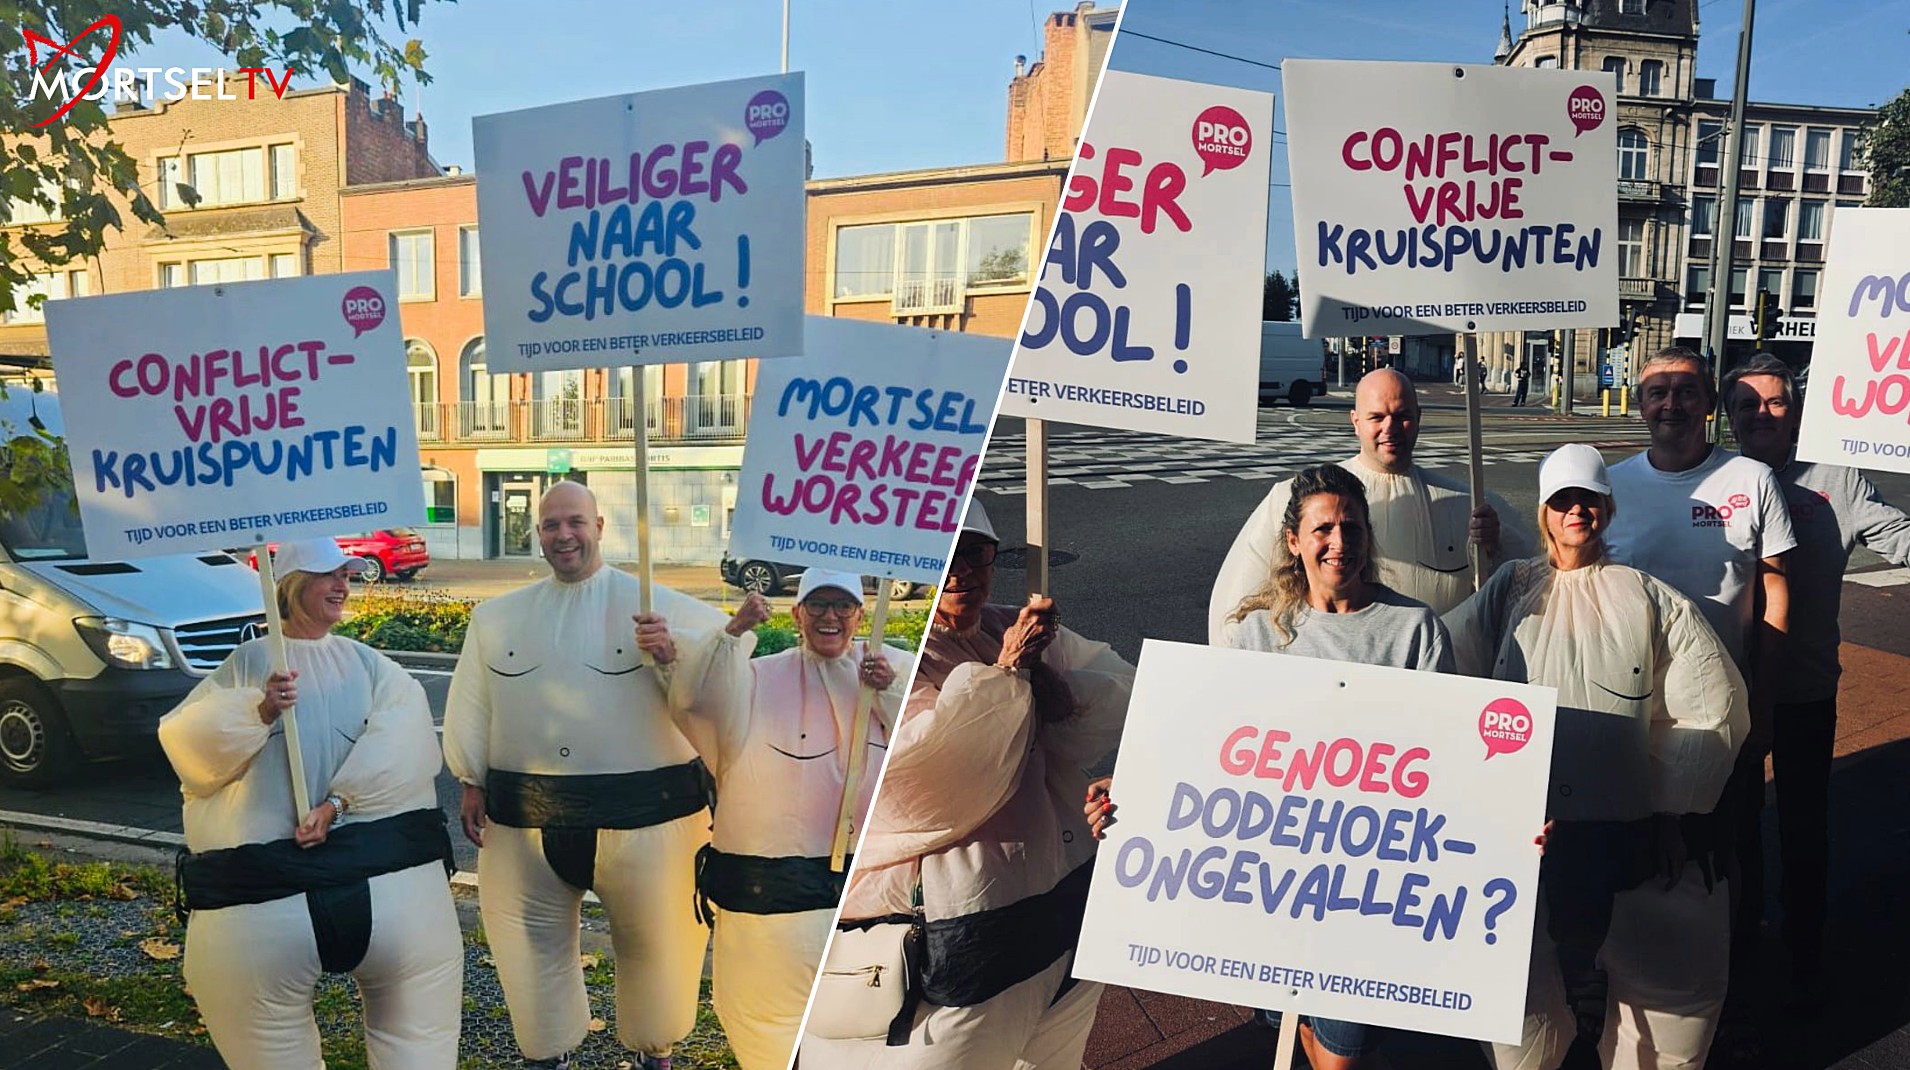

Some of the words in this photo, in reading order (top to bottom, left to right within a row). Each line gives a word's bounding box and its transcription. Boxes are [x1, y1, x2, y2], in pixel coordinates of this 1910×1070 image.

[749, 102, 787, 121] PRO
[1571, 97, 1603, 112] PRO
[1571, 112, 1602, 120] MORTSEL
[1198, 121, 1249, 147] PRO
[1198, 143, 1246, 157] MORTSEL
[1342, 127, 1574, 181] CONFLICT-
[522, 140, 748, 217] VEILIGER
[1404, 178, 1525, 227] VRIJE
[567, 200, 701, 266] NAAR
[1318, 220, 1601, 275] KRUISPUNTEN
[345, 298, 382, 314] PRO
[528, 257, 723, 323] SCHOOL
[1342, 307, 1369, 323] TIJD
[1371, 304, 1413, 319] VOOR
[1416, 304, 1442, 318] EEN
[1445, 303, 1484, 316] BETER
[1486, 300, 1587, 315] VERKEERSBELEID
[517, 343, 541, 358] TIJD
[543, 341, 580, 354] VOOR
[582, 338, 607, 351] EEN
[610, 335, 649, 350] BETER
[651, 327, 764, 346] VERKEERSBELEID
[109, 341, 355, 401] CONFLICT-
[174, 387, 305, 443] VRIJE
[778, 377, 986, 434] MORTSEL
[1006, 378, 1051, 397] ETER
[1054, 383, 1206, 416] VERKEERSBELEID
[93, 425, 397, 498] KRUISPUNTEN
[1841, 439, 1870, 455] TIJD
[125, 528, 153, 545] TIJD
[155, 523, 197, 539] VOOR
[200, 520, 226, 534] EEN
[229, 516, 272, 531] BETER
[273, 501, 388, 526] VERKEERSBELEID
[762, 473, 960, 533] WORSTEL
[1692, 505, 1733, 520] PRO
[770, 535, 796, 551] TIJD
[798, 539, 837, 556] VOOR
[840, 546, 867, 560] EEN
[869, 549, 911, 566] BETER
[1483, 729, 1526, 741] MORTSEL
[1484, 711, 1530, 732] PRO
[1220, 725, 1431, 798] GENOEG
[1167, 782, 1477, 863] DODEHOEK-
[1115, 836, 1468, 942] ONGEVALLEN
[1128, 943, 1161, 967] TIJD
[1165, 950, 1217, 975] VOOR
[1220, 959, 1256, 980] EEN
[1259, 965, 1315, 990] BETER
[1319, 973, 1473, 1011] VERKEERSBELEID
